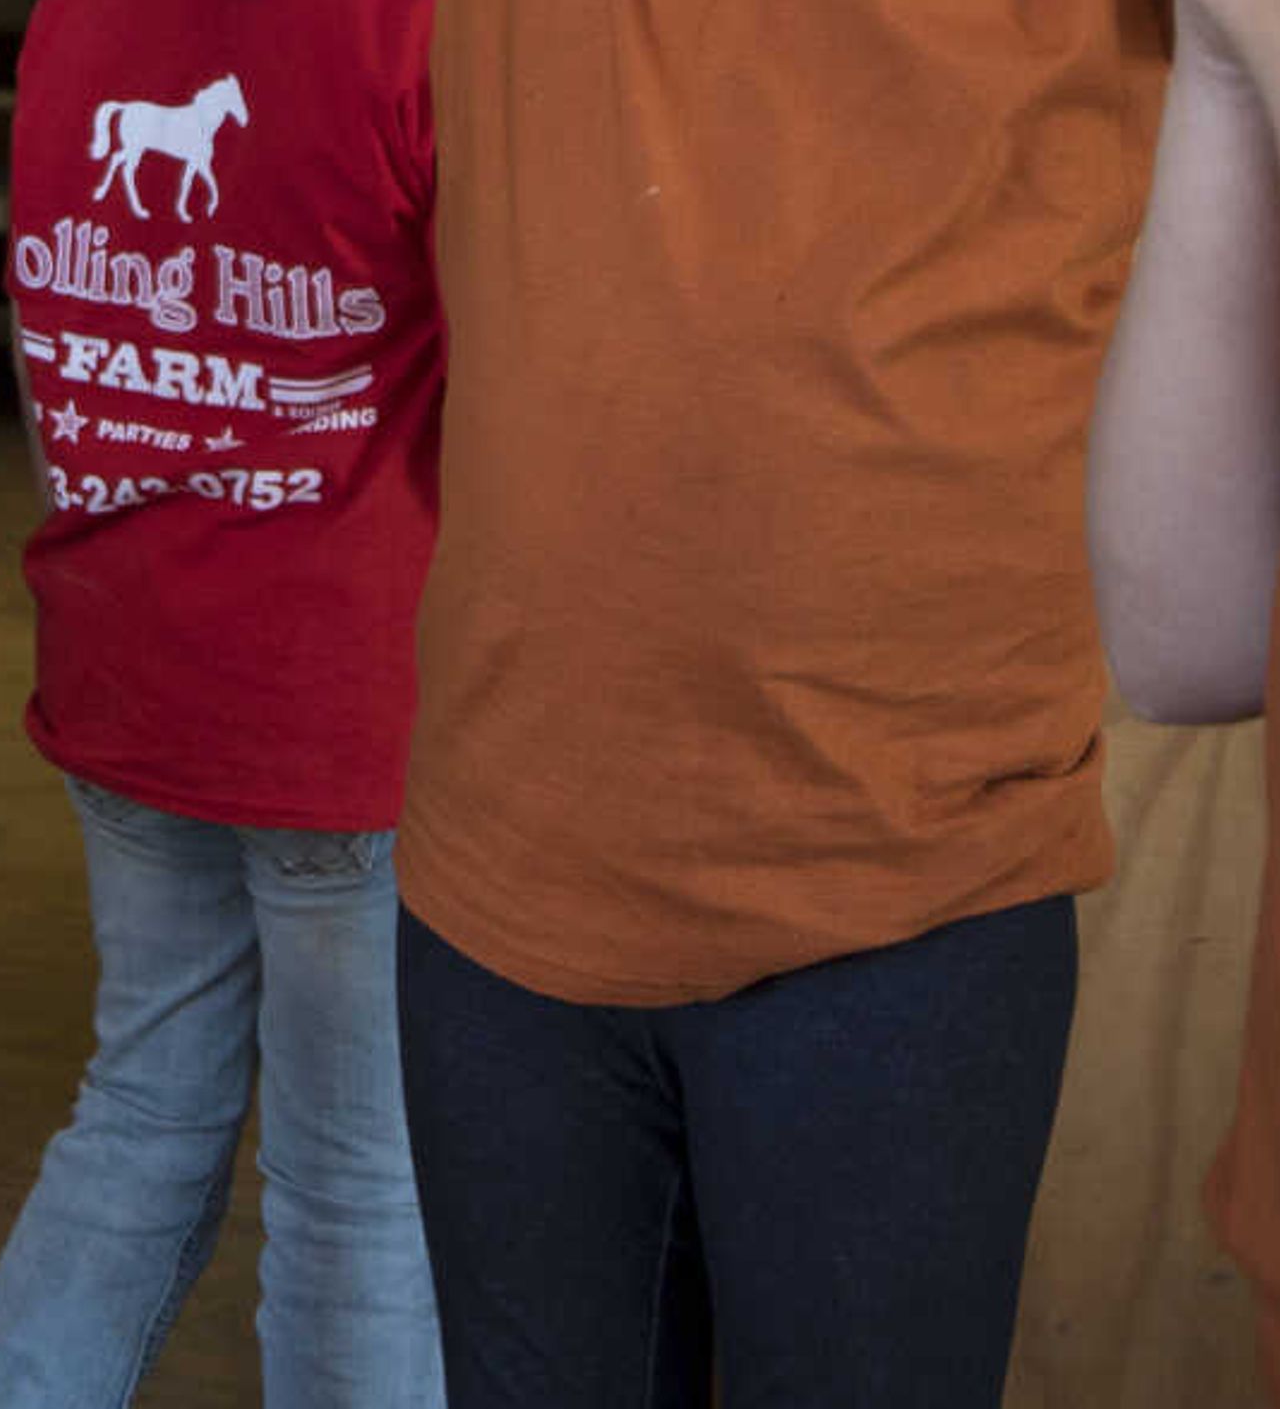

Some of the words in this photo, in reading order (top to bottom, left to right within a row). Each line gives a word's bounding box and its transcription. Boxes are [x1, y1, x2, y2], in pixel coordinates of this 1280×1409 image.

[15, 216, 197, 333] olling
[213, 244, 387, 339] Hills
[59, 333, 267, 413] FARM
[96, 419, 193, 453] PARTIES
[48, 465, 324, 516] 3-240752
